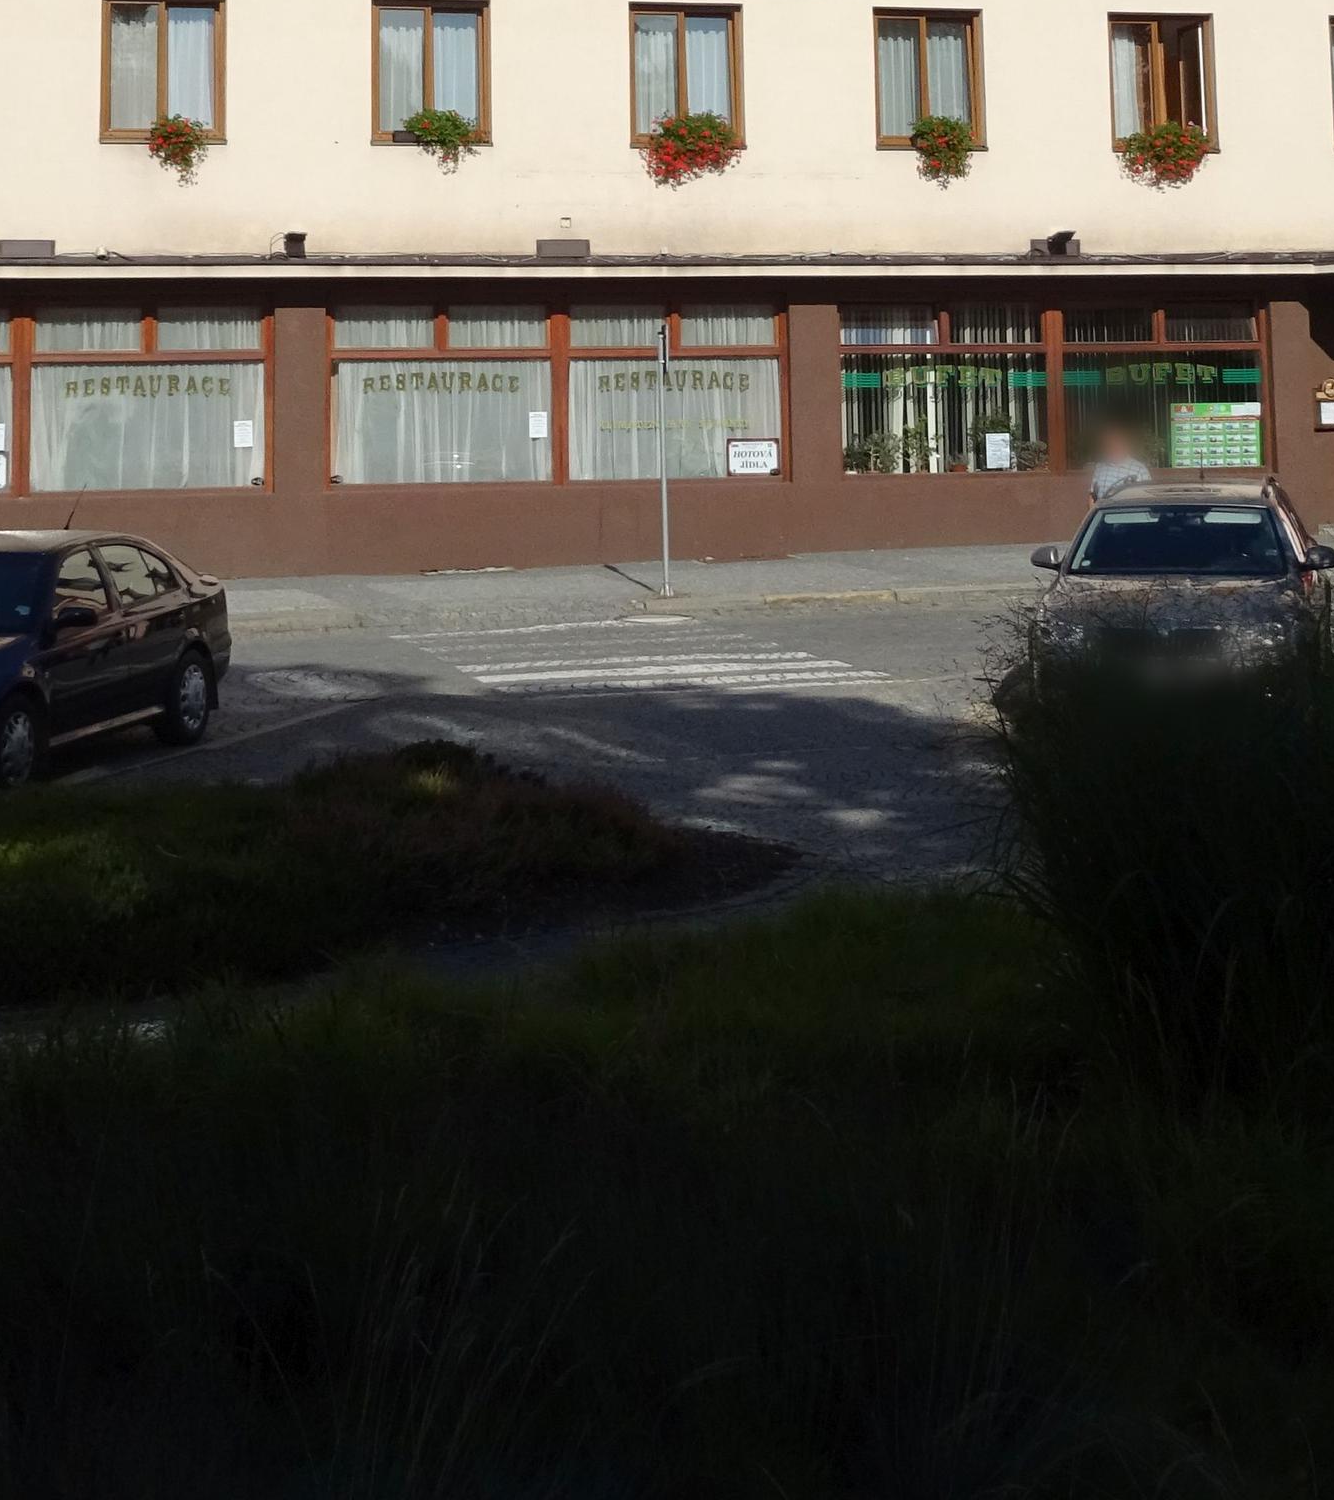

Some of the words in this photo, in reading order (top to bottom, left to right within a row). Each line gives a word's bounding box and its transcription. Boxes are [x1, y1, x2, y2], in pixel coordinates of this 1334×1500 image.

[65, 374, 231, 398] RESTAURACE
[362, 371, 520, 395] RESTAURACE
[598, 370, 750, 393] RESTAURACE
[883, 365, 1002, 387] BUFET
[1105, 363, 1217, 386] BUFET
[733, 449, 773, 458] HOTOVÁ
[739, 459, 768, 469] JÍDLA
